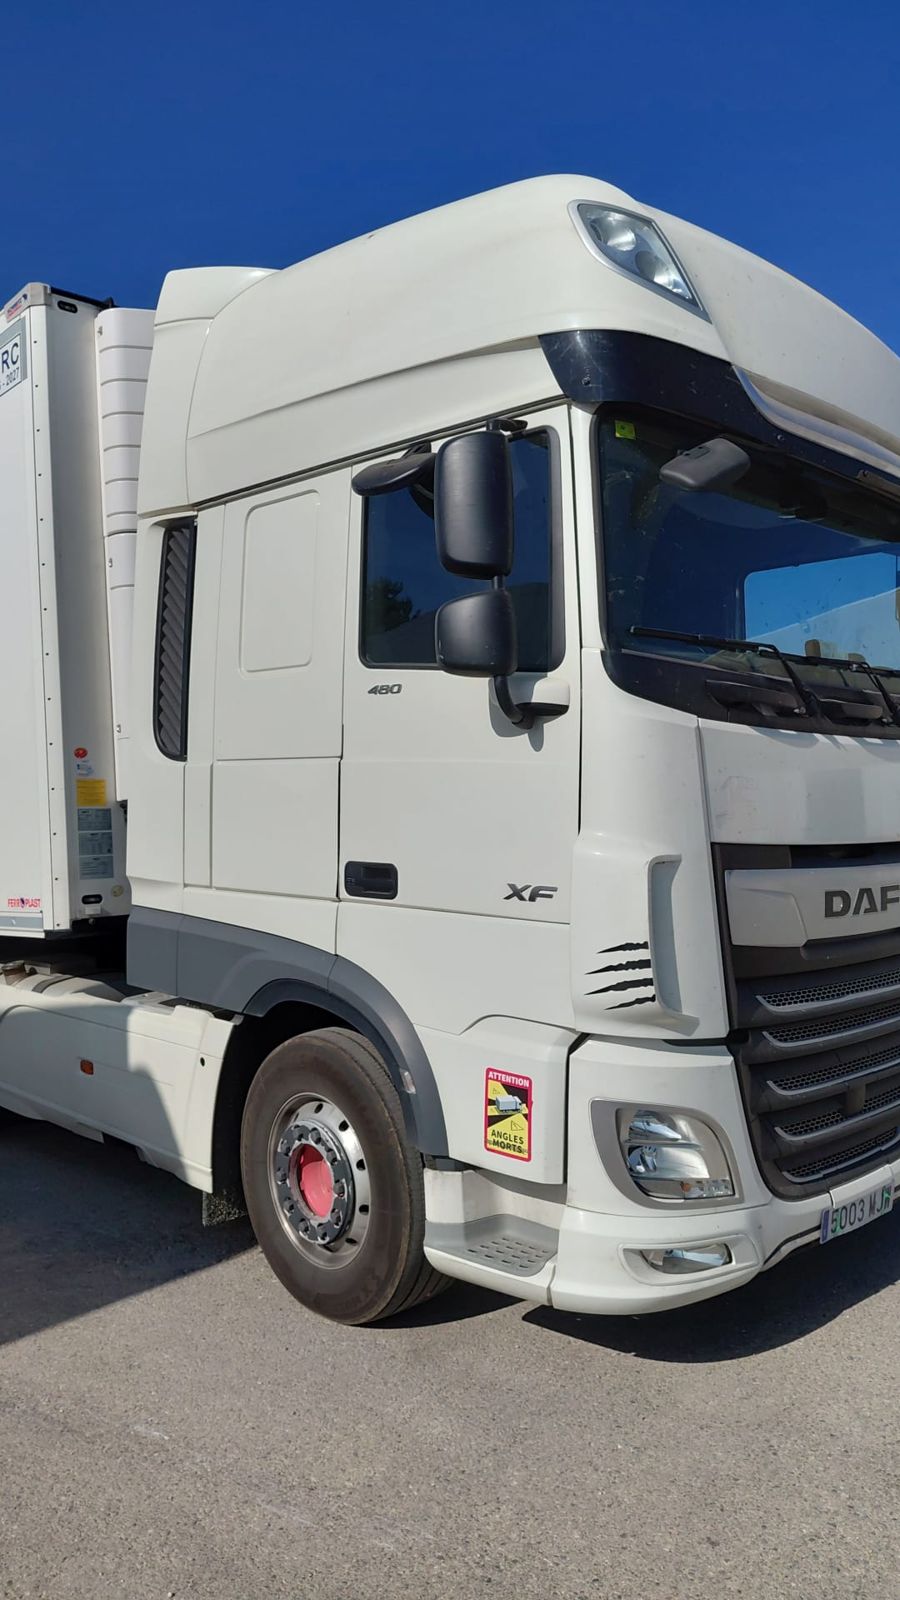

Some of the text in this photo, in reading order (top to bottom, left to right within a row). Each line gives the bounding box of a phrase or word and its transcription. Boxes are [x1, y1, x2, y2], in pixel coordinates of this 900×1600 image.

[367, 683, 402, 695] 480
[503, 883, 558, 902] XF
[825, 885, 900, 917] DAF
[488, 1071, 529, 1087] ATTENTION
[491, 1129, 524, 1145] ANGLES
[493, 1138, 523, 1154] MORTS
[831, 1198, 865, 1233] 5003
